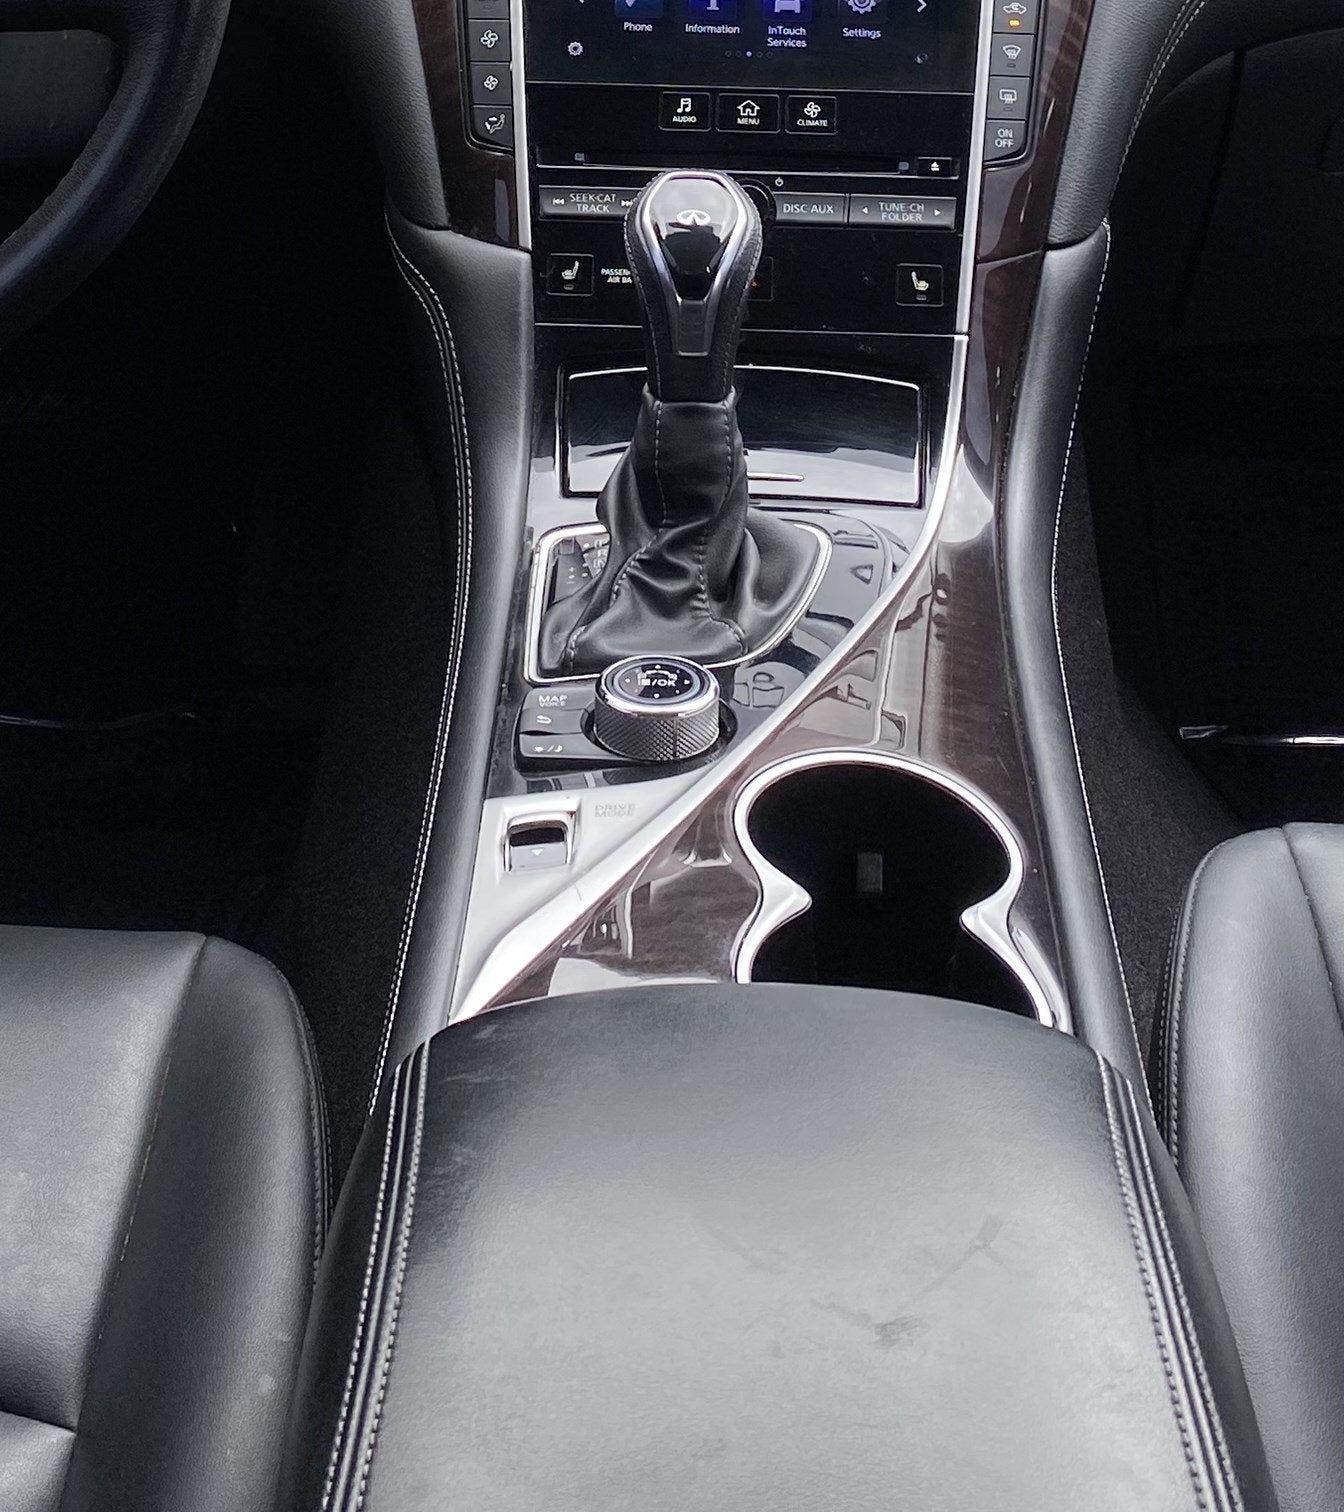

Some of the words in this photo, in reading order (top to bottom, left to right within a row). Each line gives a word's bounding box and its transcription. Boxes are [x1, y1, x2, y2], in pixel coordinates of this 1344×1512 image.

[623, 21, 653, 33] Phone
[685, 23, 741, 35] Information
[767, 25, 807, 38] InTouch
[842, 27, 882, 40] Settings
[767, 37, 807, 49] Services
[672, 115, 697, 124] AUDIO
[736, 116, 761, 126] MENU
[796, 118, 828, 128] CLIMATE
[997, 128, 1014, 139] ON
[994, 138, 1015, 149] OFF
[575, 202, 610, 214] TRACK
[881, 212, 923, 223] FOLDER
[538, 695, 568, 704] MAP
[594, 804, 635, 812] DRIVE
